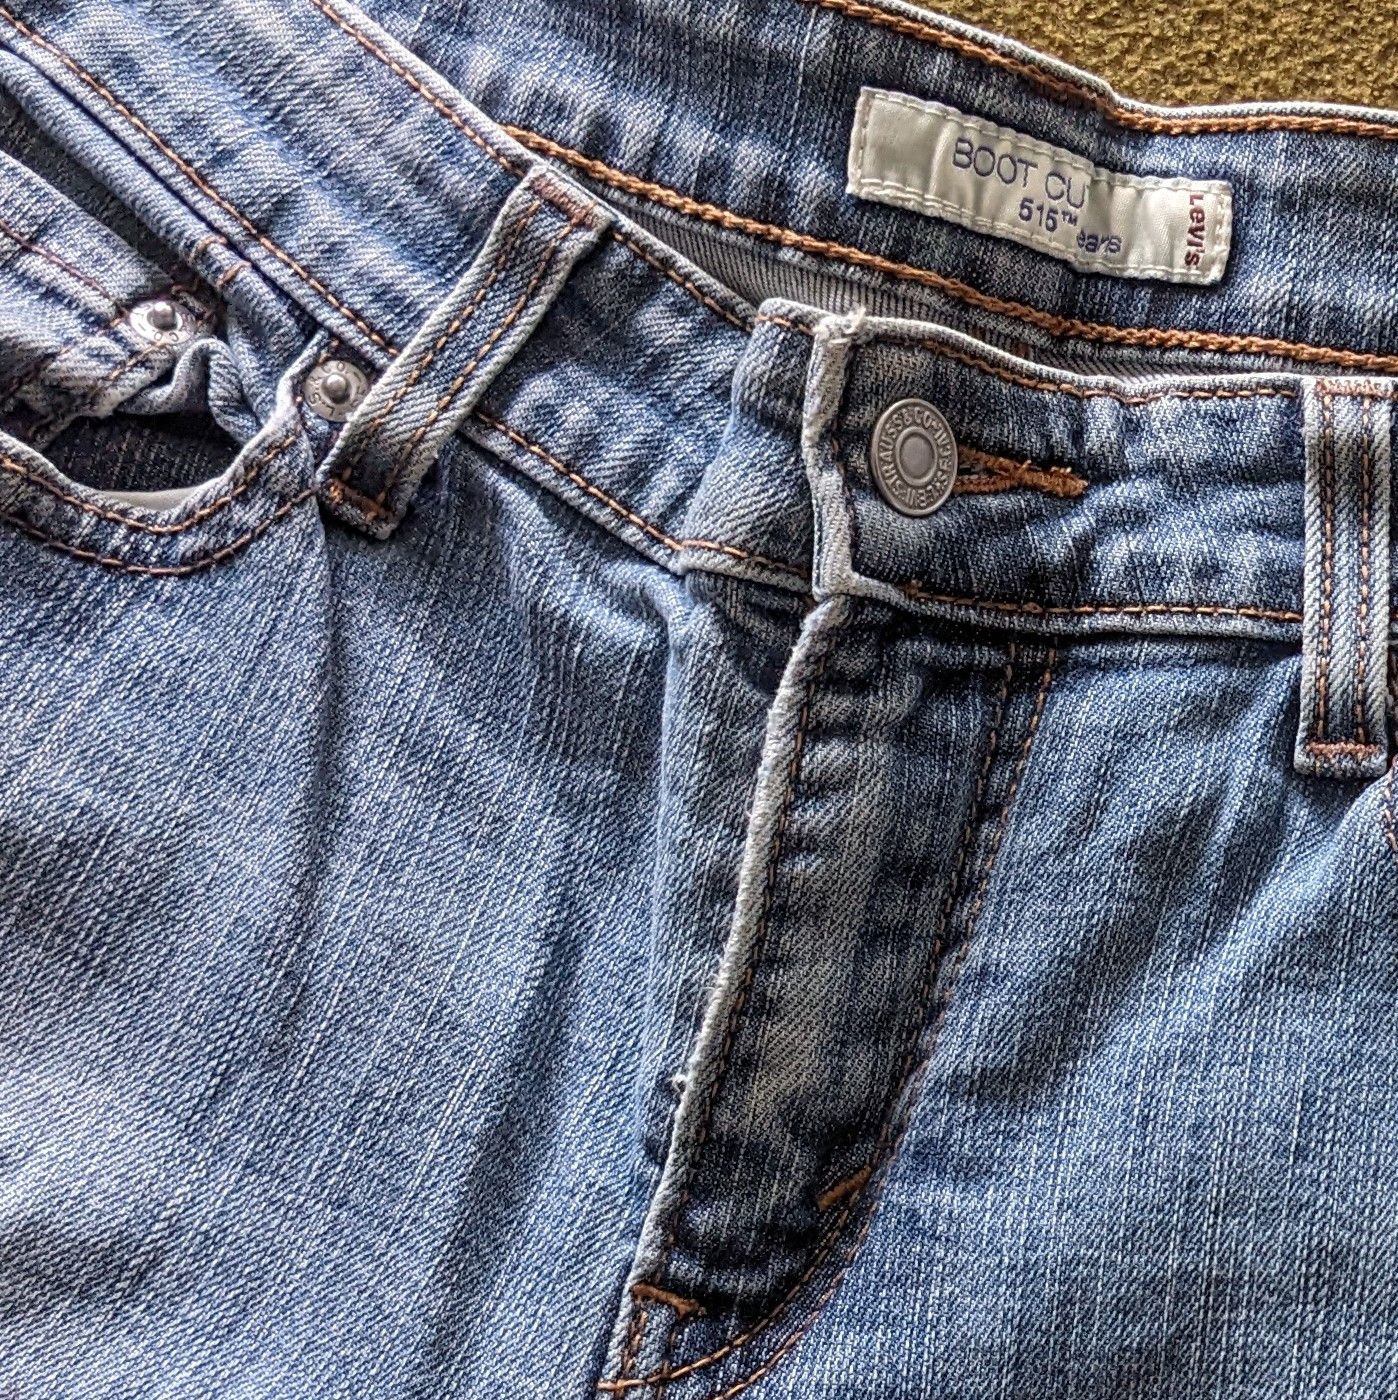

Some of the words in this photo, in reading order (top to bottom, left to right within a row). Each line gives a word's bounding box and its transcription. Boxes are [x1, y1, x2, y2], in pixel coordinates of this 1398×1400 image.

[952, 137, 1039, 188] BOOT
[1045, 172, 1090, 209] CU
[1184, 194, 1207, 267] Levi's
